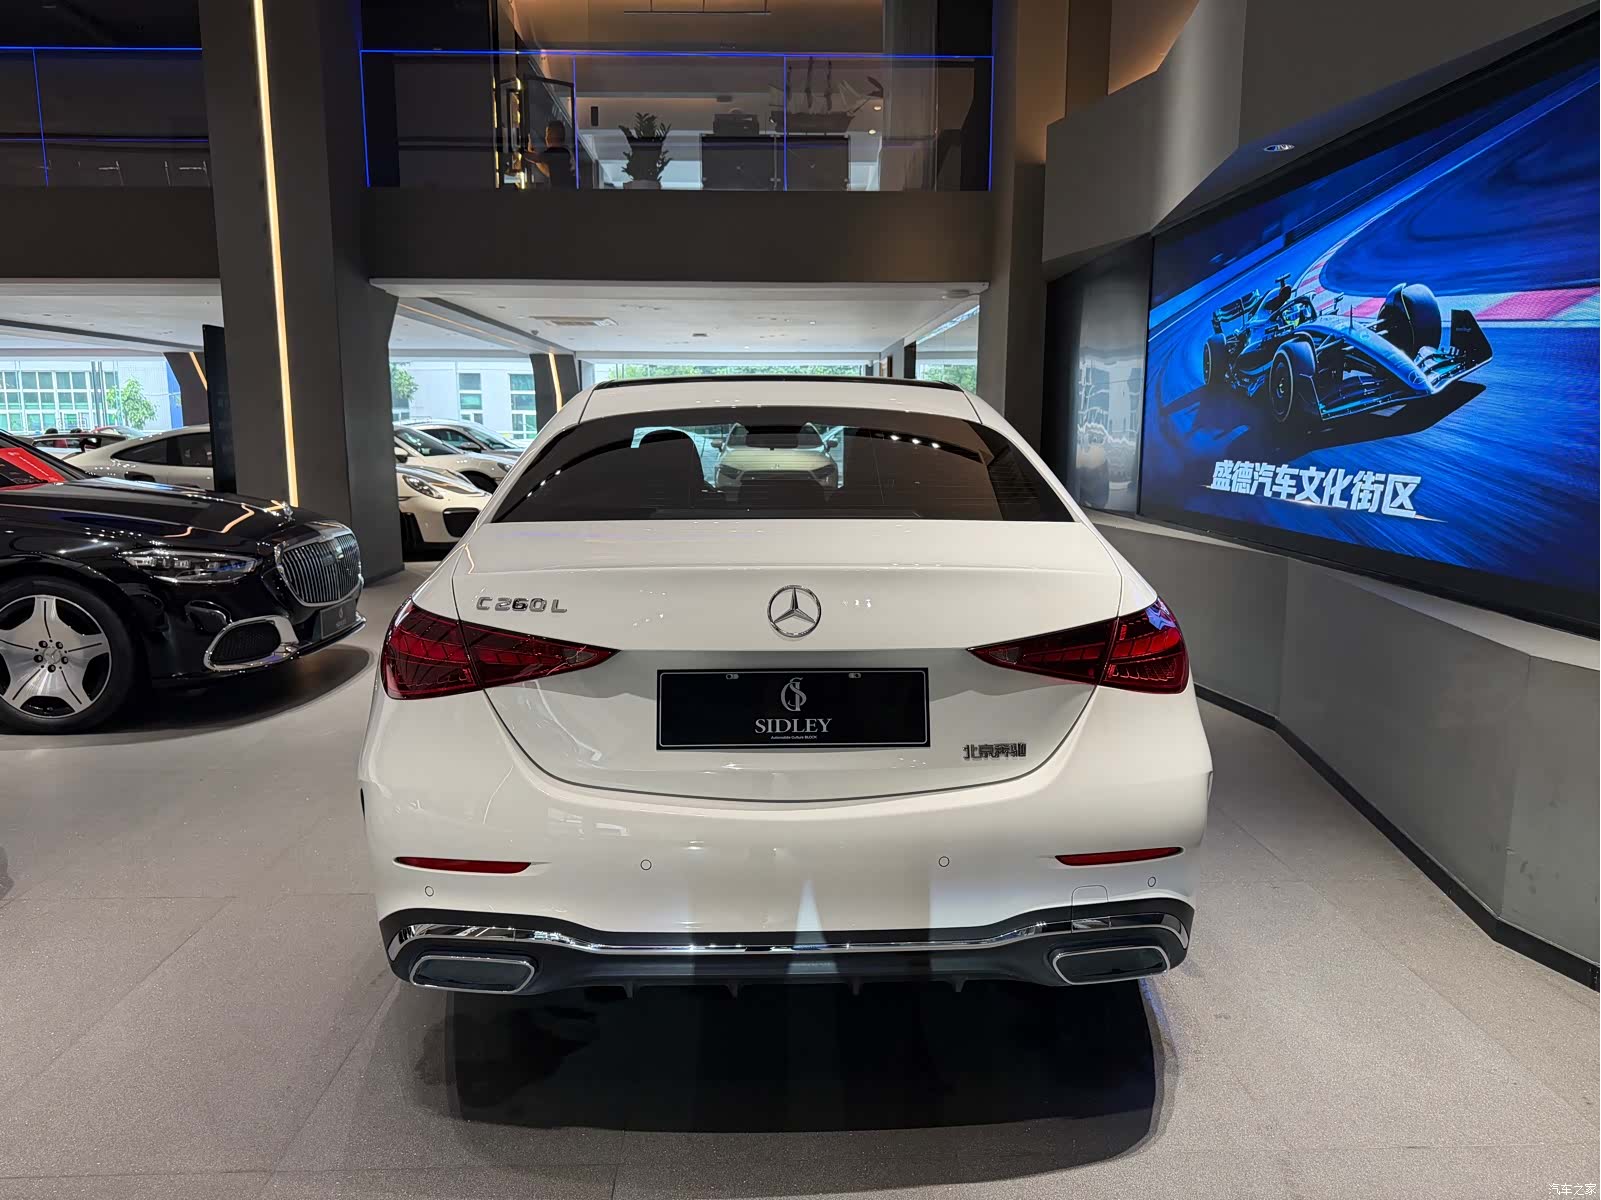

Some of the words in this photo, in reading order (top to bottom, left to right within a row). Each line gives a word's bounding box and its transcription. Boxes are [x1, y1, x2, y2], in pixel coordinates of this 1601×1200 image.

[1210, 459, 1422, 519] 盛德汽车文化街区
[476, 596, 493, 611] C
[494, 597, 548, 613] 260
[550, 599, 568, 614] L
[754, 718, 832, 733] SIDLEY
[962, 742, 1027, 760] 北京奔驰
